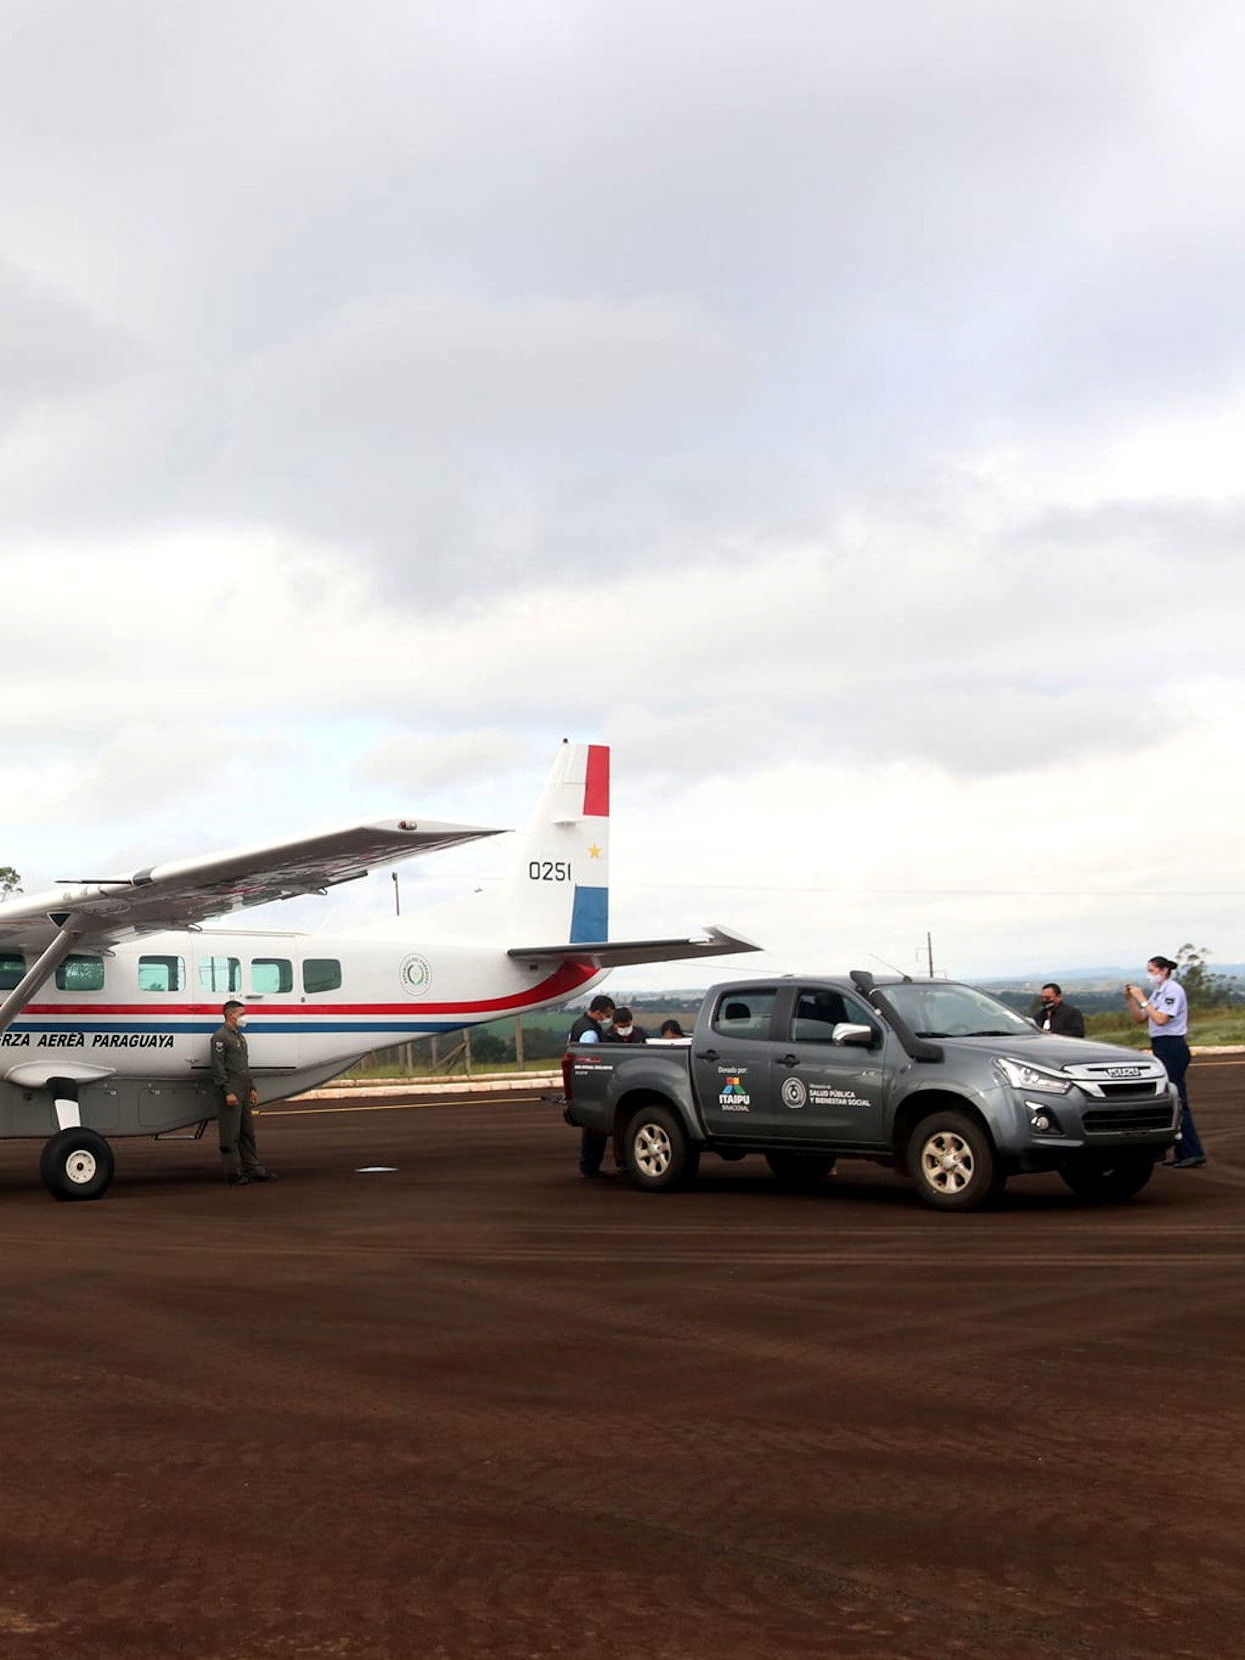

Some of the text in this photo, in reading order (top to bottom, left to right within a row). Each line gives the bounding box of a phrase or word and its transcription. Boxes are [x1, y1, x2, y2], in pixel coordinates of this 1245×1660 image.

[529, 861, 571, 881] 0251
[91, 1034, 174, 1048] PARAGUAYA
[1108, 1067, 1139, 1077] ISUZU
[809, 1089, 856, 1099] SALUD PÚBLICA
[719, 1094, 750, 1105] ITAIPU
[815, 1097, 847, 1105] BIENESTAR
[847, 1098, 872, 1107] SOCIAL
